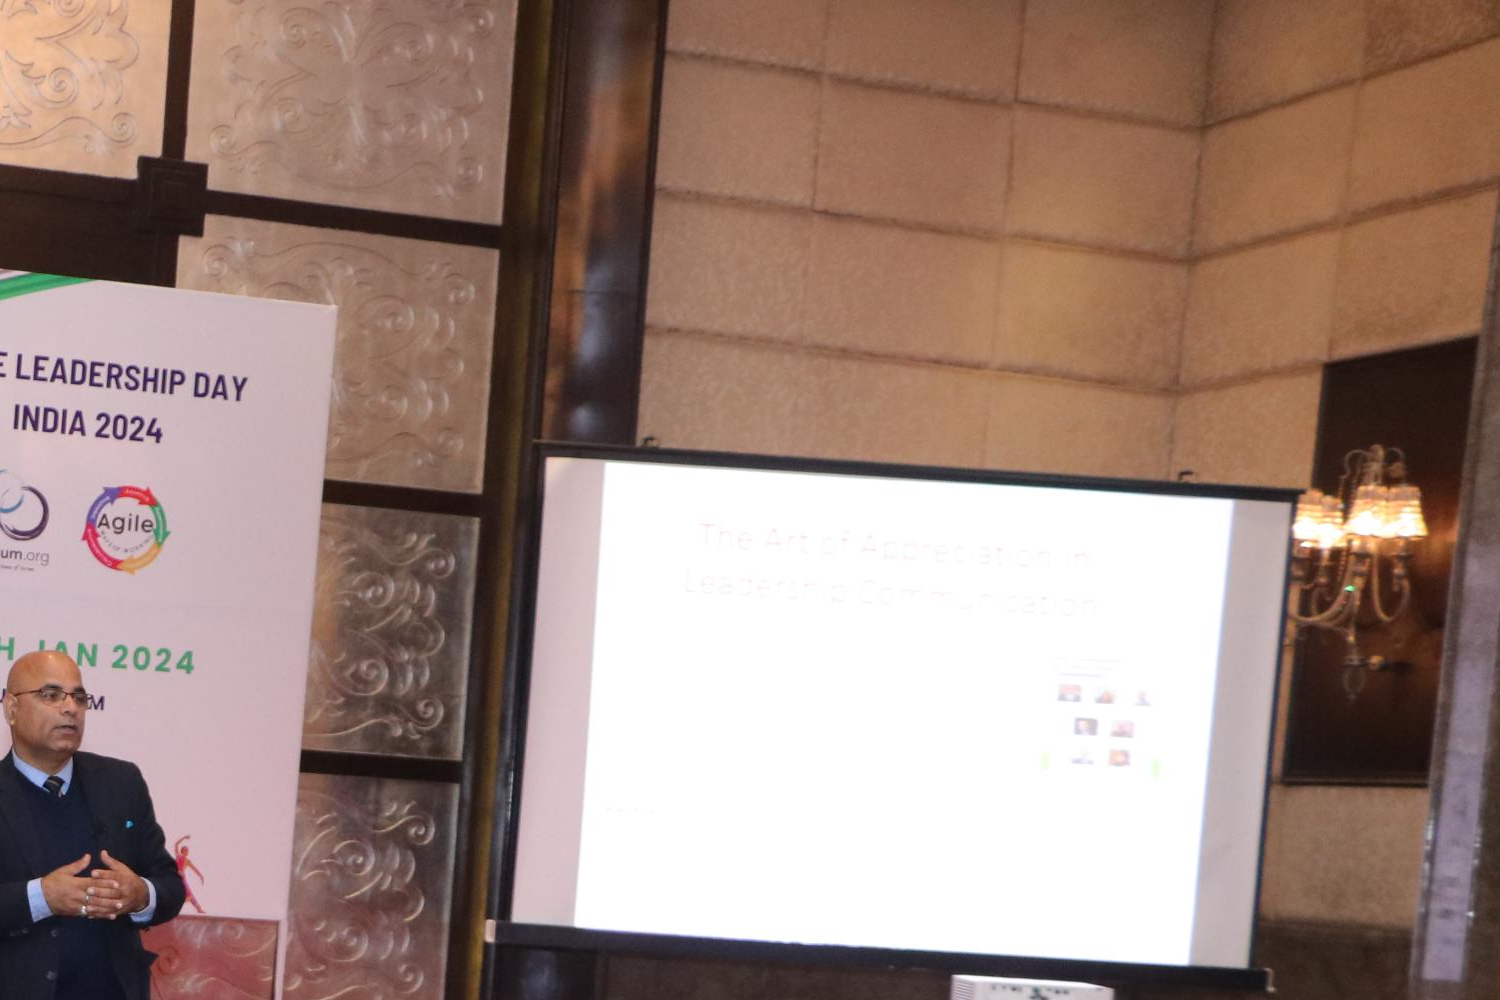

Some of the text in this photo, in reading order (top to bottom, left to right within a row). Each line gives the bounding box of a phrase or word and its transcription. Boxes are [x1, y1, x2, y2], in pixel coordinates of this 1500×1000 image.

[15, 353, 186, 395] LEADERSHIP
[193, 372, 248, 401] DAY
[12, 404, 164, 444] INDIA 2024
[97, 512, 155, 535] Agile
[699, 522, 753, 550] The
[111, 644, 195, 674] 2024
